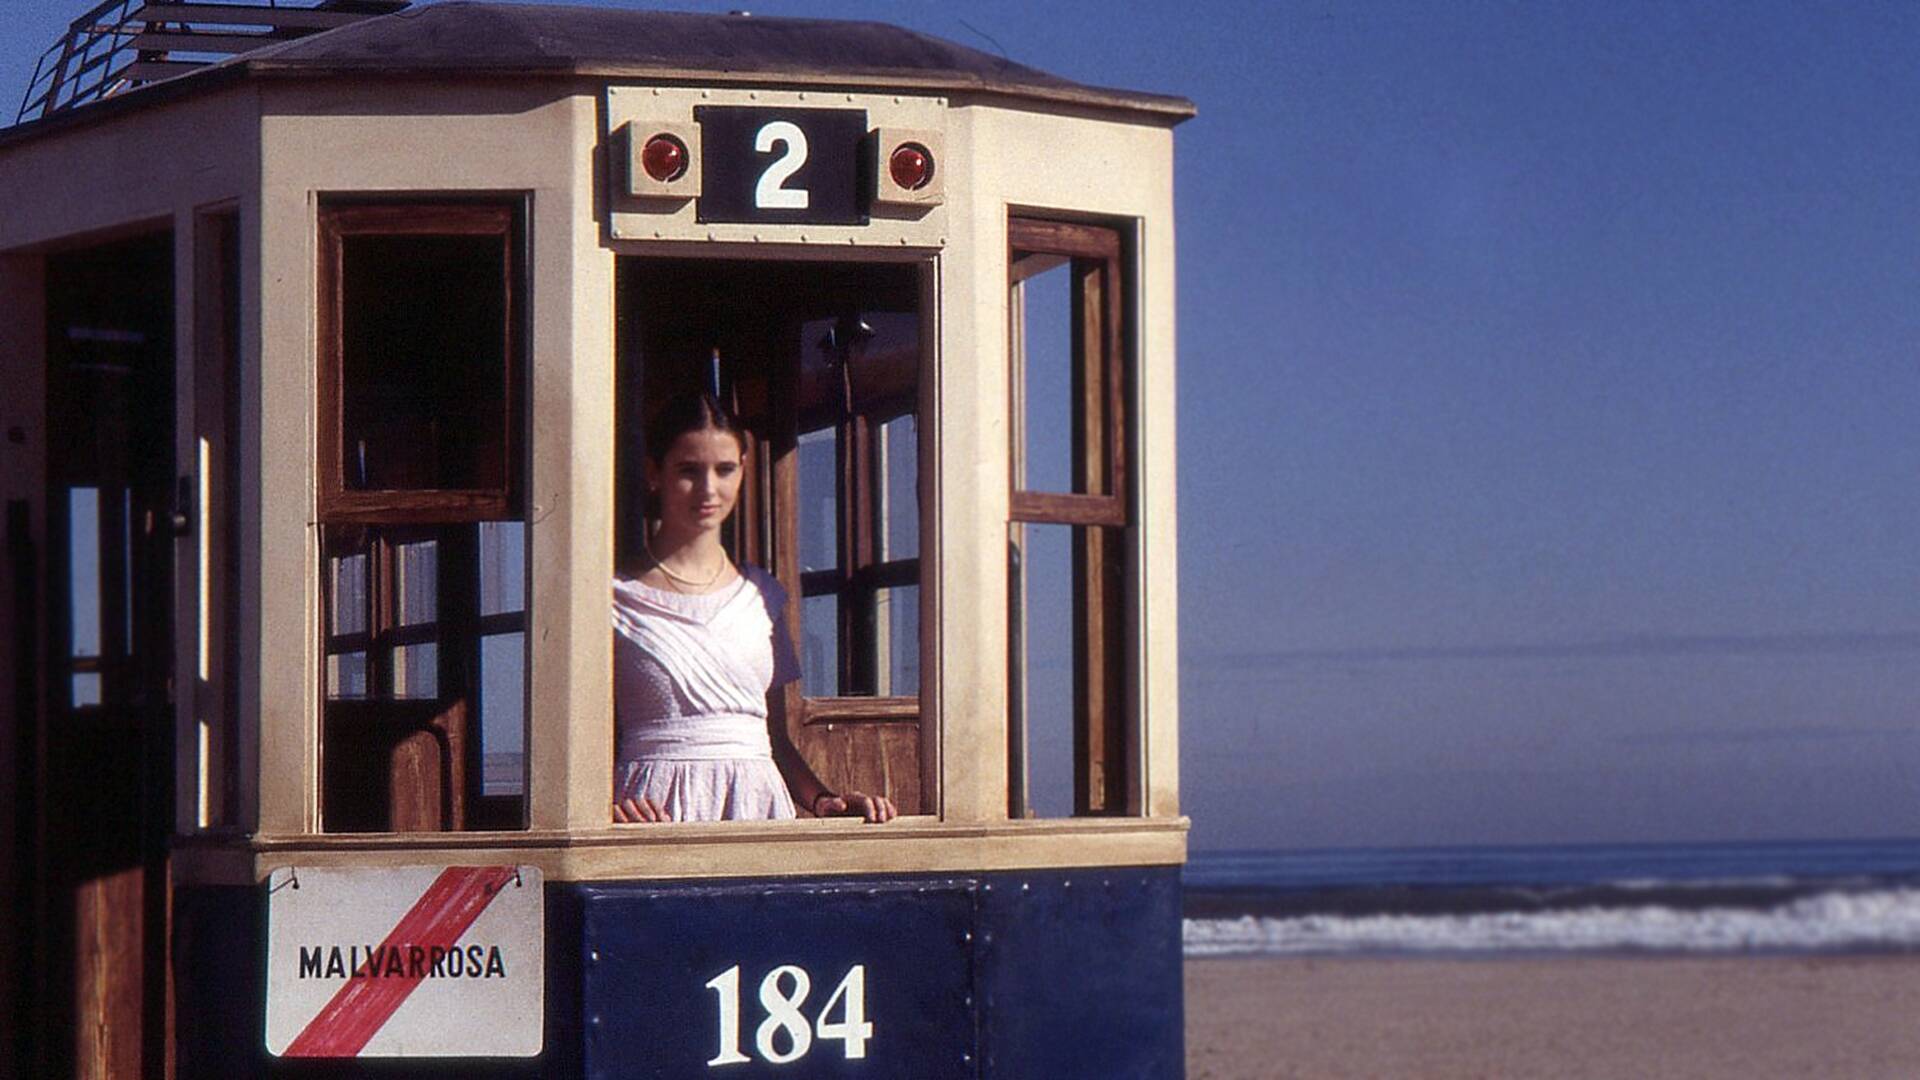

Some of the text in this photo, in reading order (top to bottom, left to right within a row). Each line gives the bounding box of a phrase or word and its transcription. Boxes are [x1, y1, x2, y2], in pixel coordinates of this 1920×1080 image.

[754, 120, 810, 210] 2
[299, 945, 505, 979] MALVARROSA
[705, 964, 873, 1067] 184
